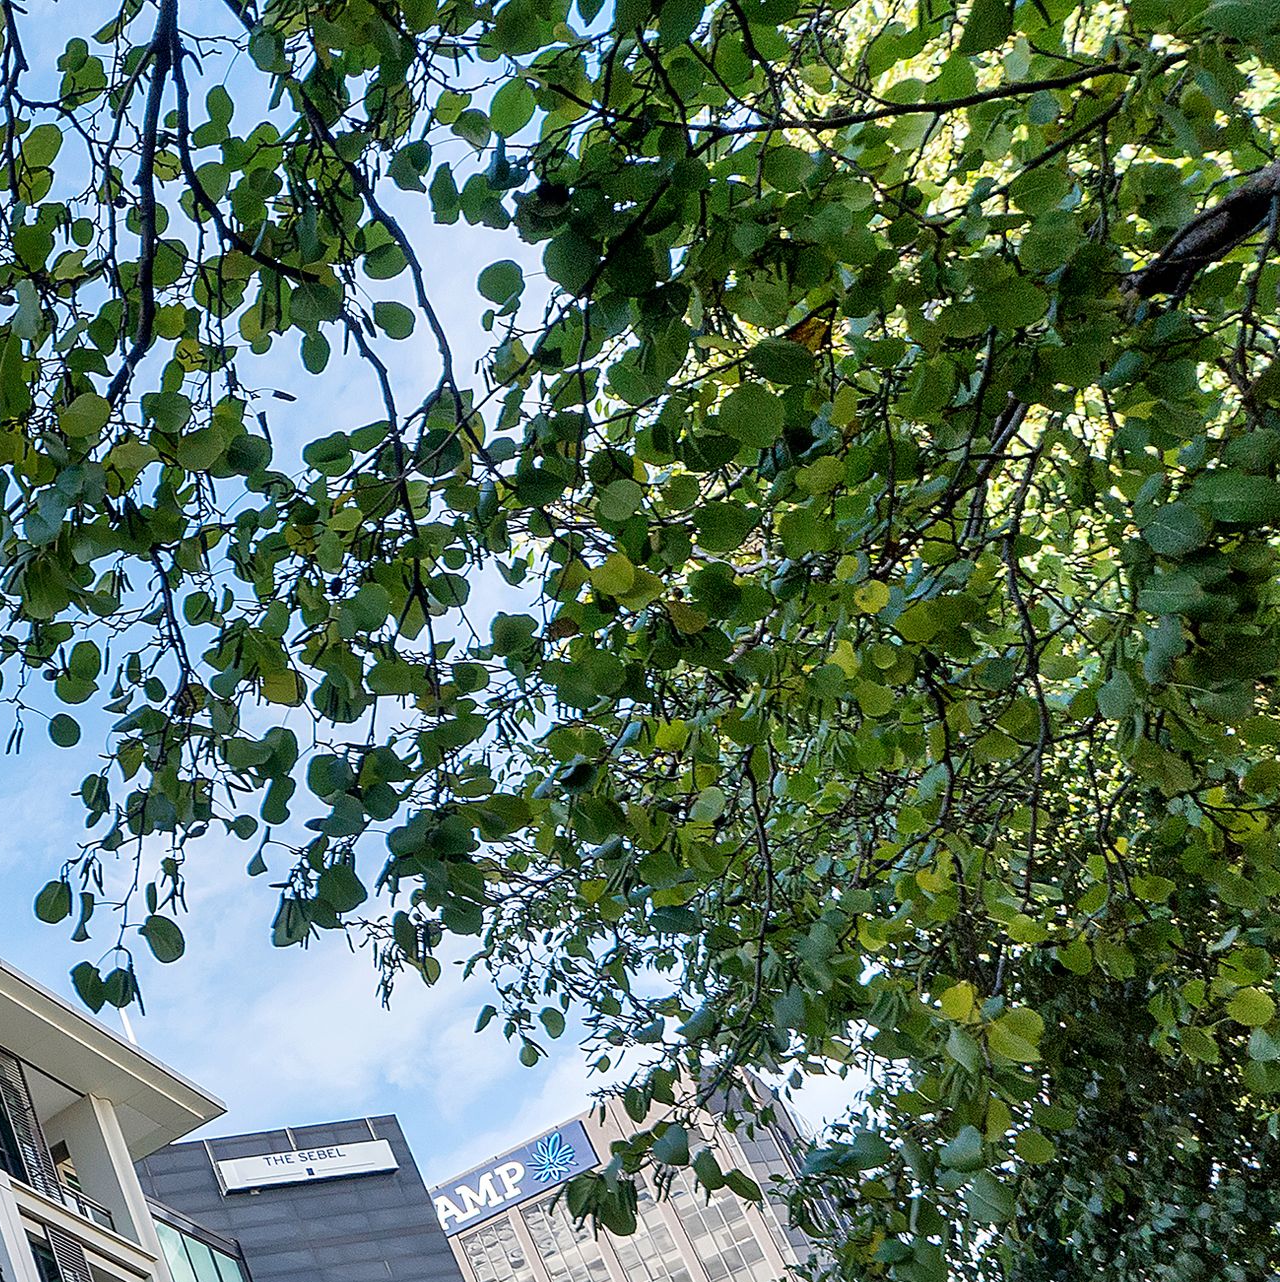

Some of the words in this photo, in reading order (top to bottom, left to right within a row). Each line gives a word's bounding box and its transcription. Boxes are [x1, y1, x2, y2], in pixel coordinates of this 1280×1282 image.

[263, 1154, 295, 1167] THE
[297, 1147, 346, 1163] SEBEL
[433, 1161, 525, 1231] AMP
